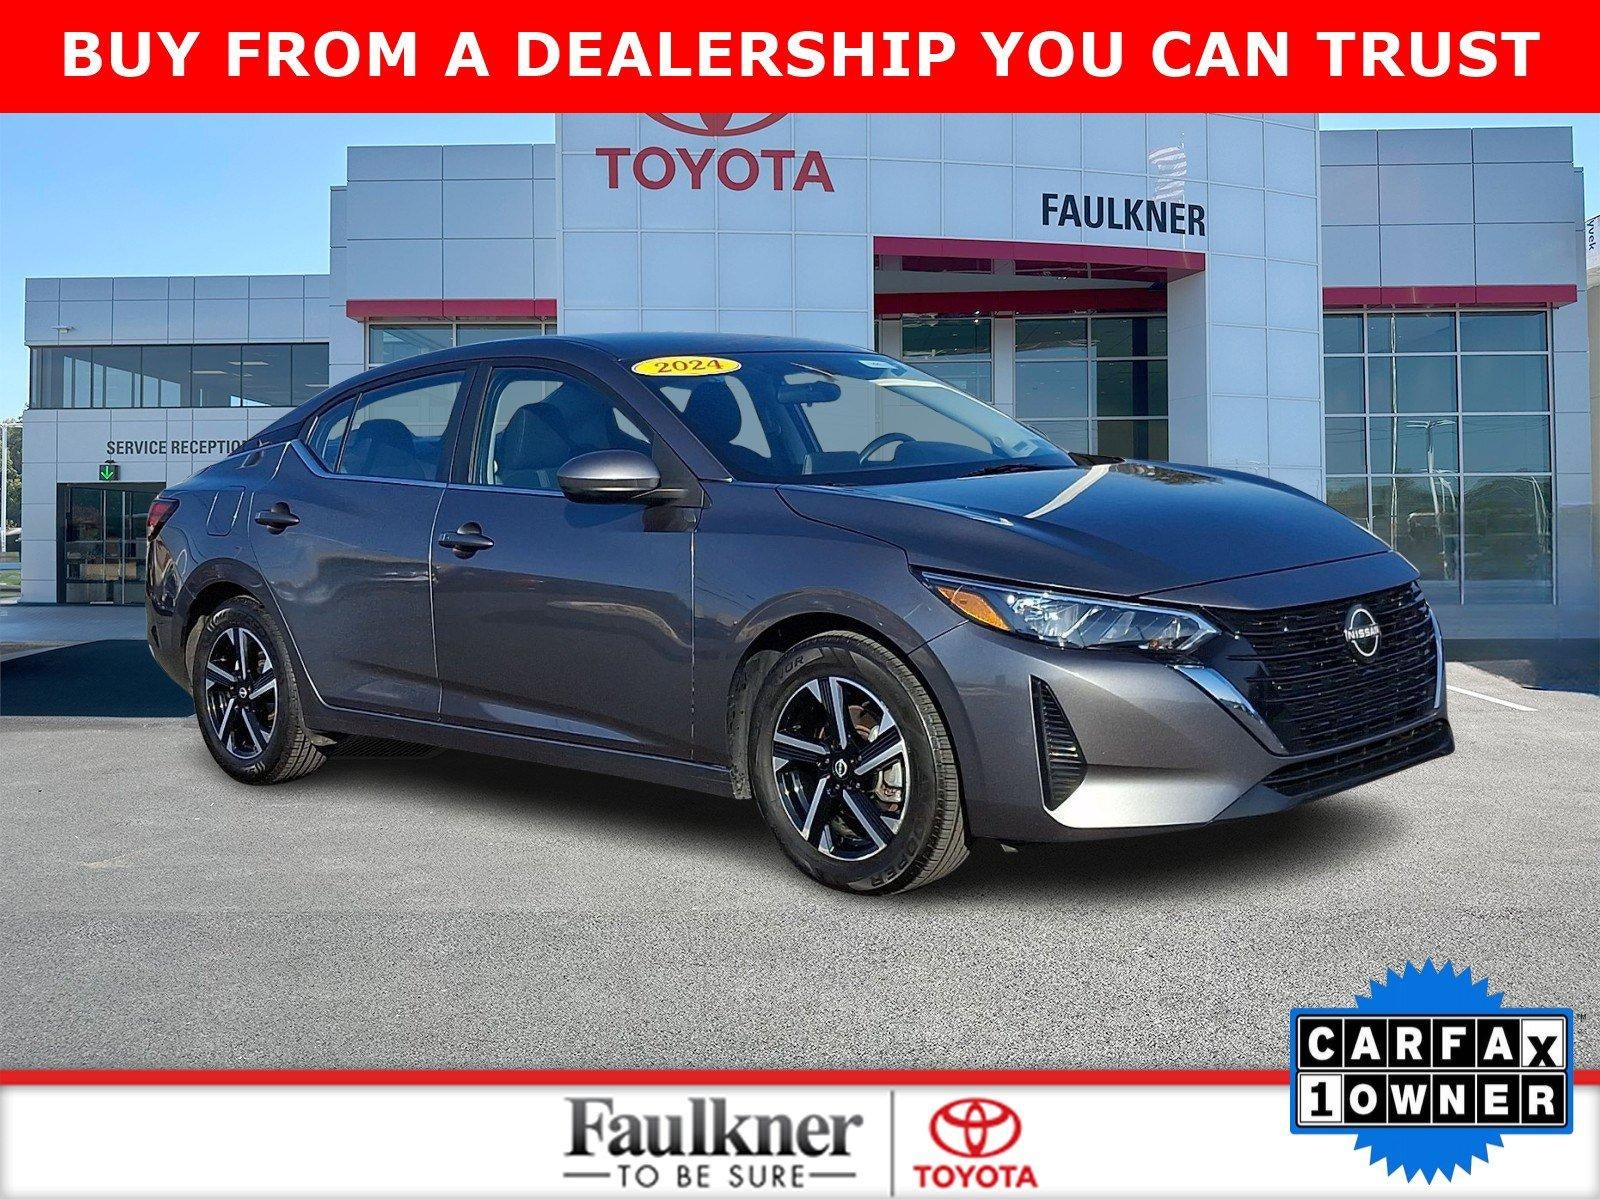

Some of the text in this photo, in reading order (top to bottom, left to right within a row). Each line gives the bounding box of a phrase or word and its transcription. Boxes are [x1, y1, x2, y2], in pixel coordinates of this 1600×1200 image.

[595, 146, 835, 192] TOYOTA
[1042, 193, 1206, 236] FAULKNER
[654, 359, 723, 373] 2024
[106, 440, 248, 454] SERVICE RECEPTIO
[1347, 625, 1379, 640] NISSAN
